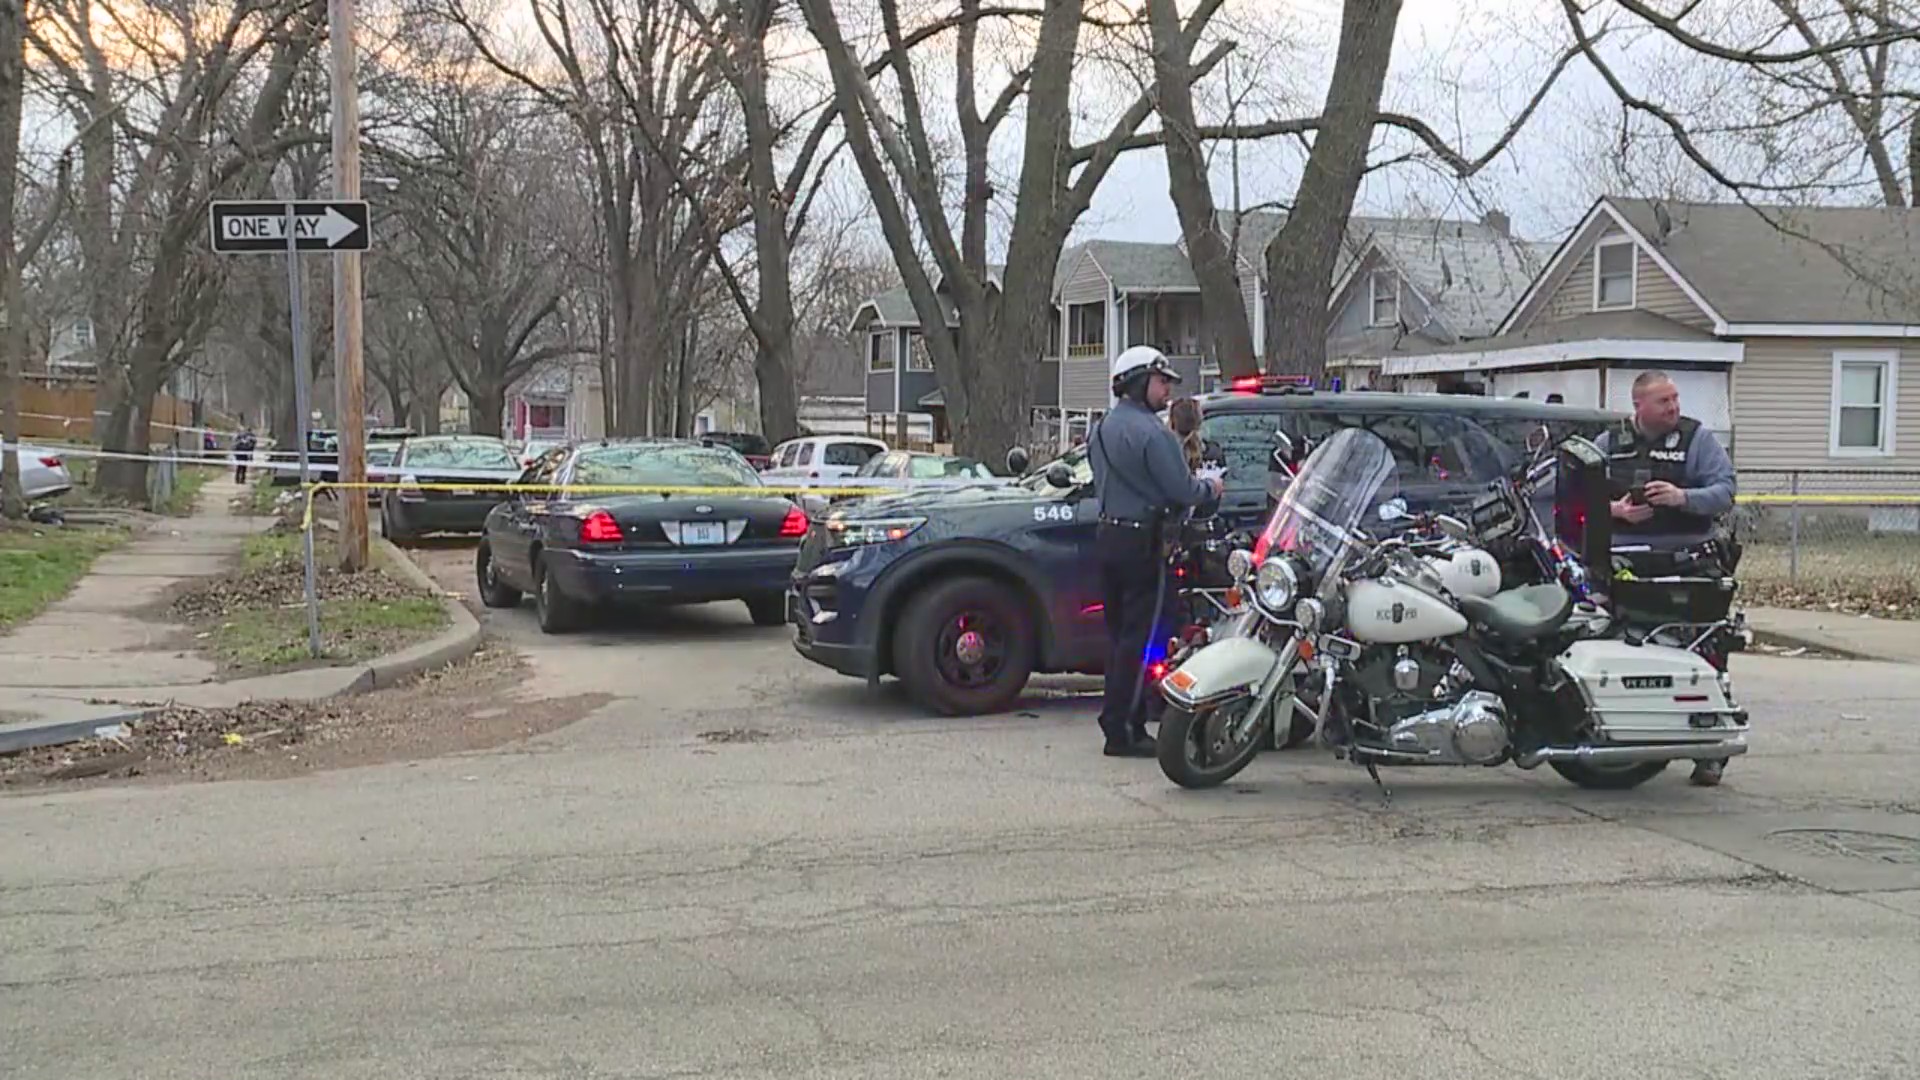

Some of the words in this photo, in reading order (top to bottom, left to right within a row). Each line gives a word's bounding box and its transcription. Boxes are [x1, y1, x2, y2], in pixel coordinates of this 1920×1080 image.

[228, 218, 270, 237] ONE
[1649, 449, 1686, 462] POLICE
[1034, 504, 1073, 521] 546
